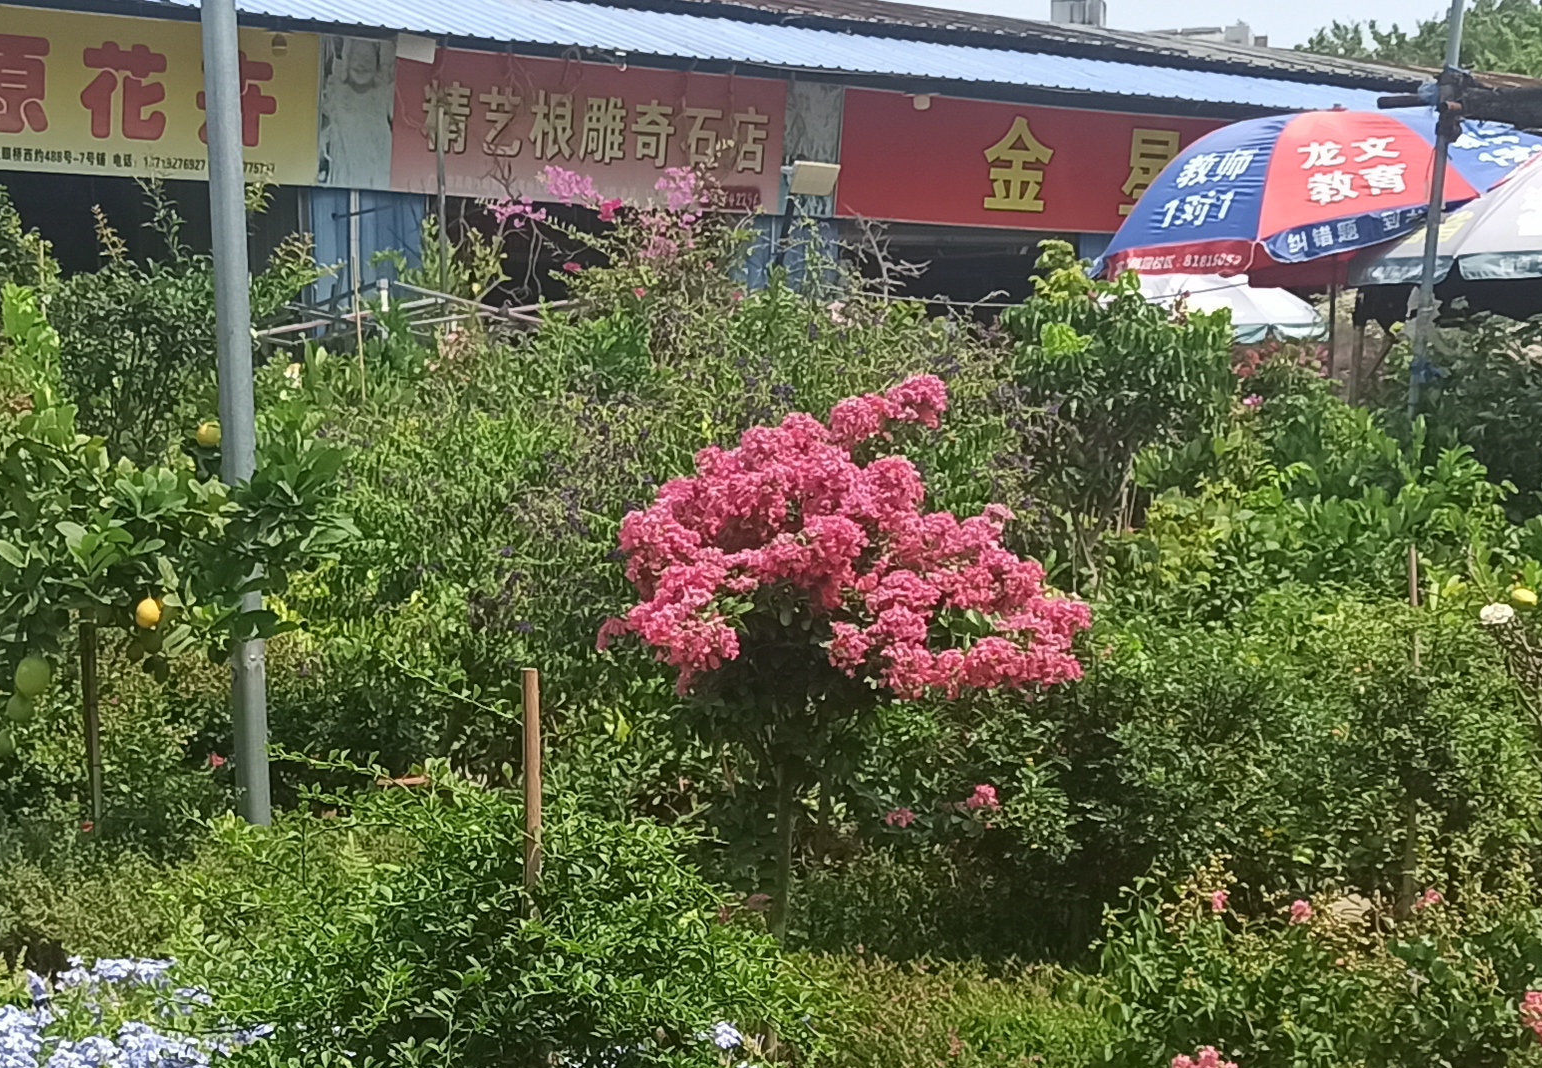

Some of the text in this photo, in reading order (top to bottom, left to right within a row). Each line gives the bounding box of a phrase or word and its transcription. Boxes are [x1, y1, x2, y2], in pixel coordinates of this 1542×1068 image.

[421, 79, 770, 174] 精艺根雕奇石店
[1175, 147, 1260, 189] 教师
[1296, 136, 1402, 171] 龙文
[1306, 162, 1407, 206] 教育
